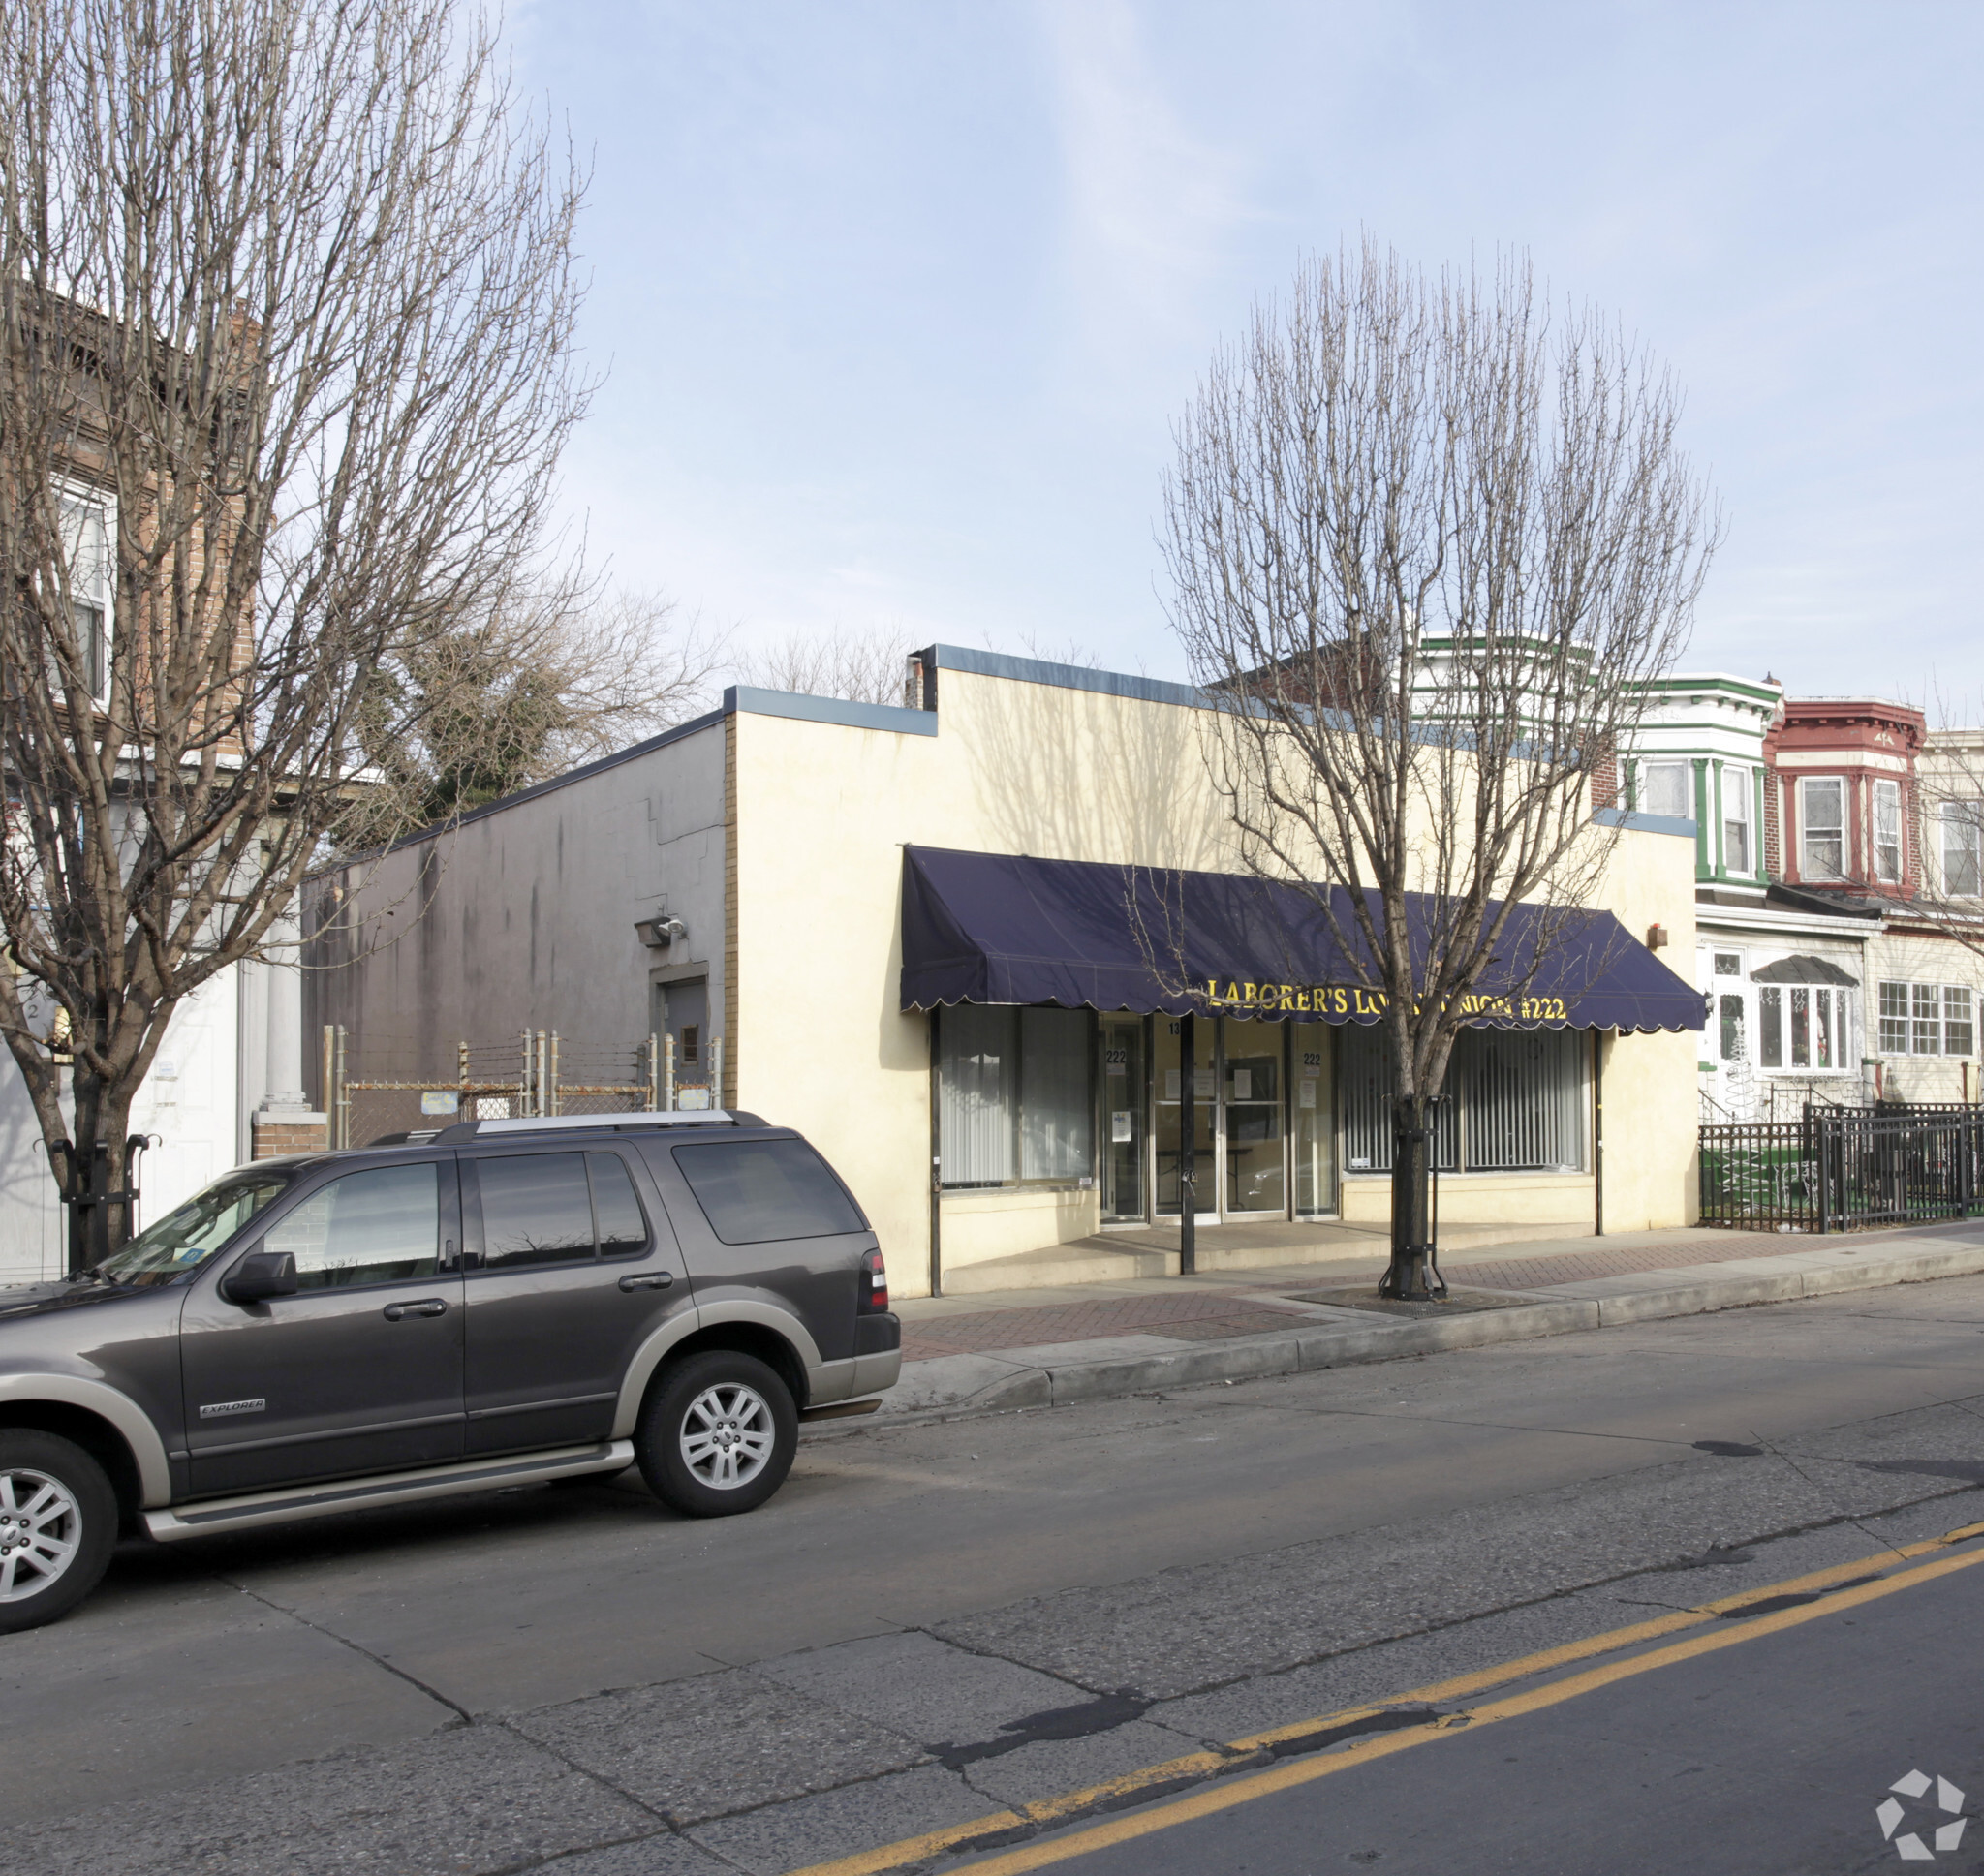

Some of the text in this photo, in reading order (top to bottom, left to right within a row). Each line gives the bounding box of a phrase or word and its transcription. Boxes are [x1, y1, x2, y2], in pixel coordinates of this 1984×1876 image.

[1207, 979, 1348, 1014] LABORER'S
[1441, 993, 1513, 1019] NION
[1520, 997, 1567, 1020] #222
[1106, 1050, 1126, 1063] 222
[1304, 1053, 1320, 1065] 222
[202, 1399, 264, 1414] EXPLORER
